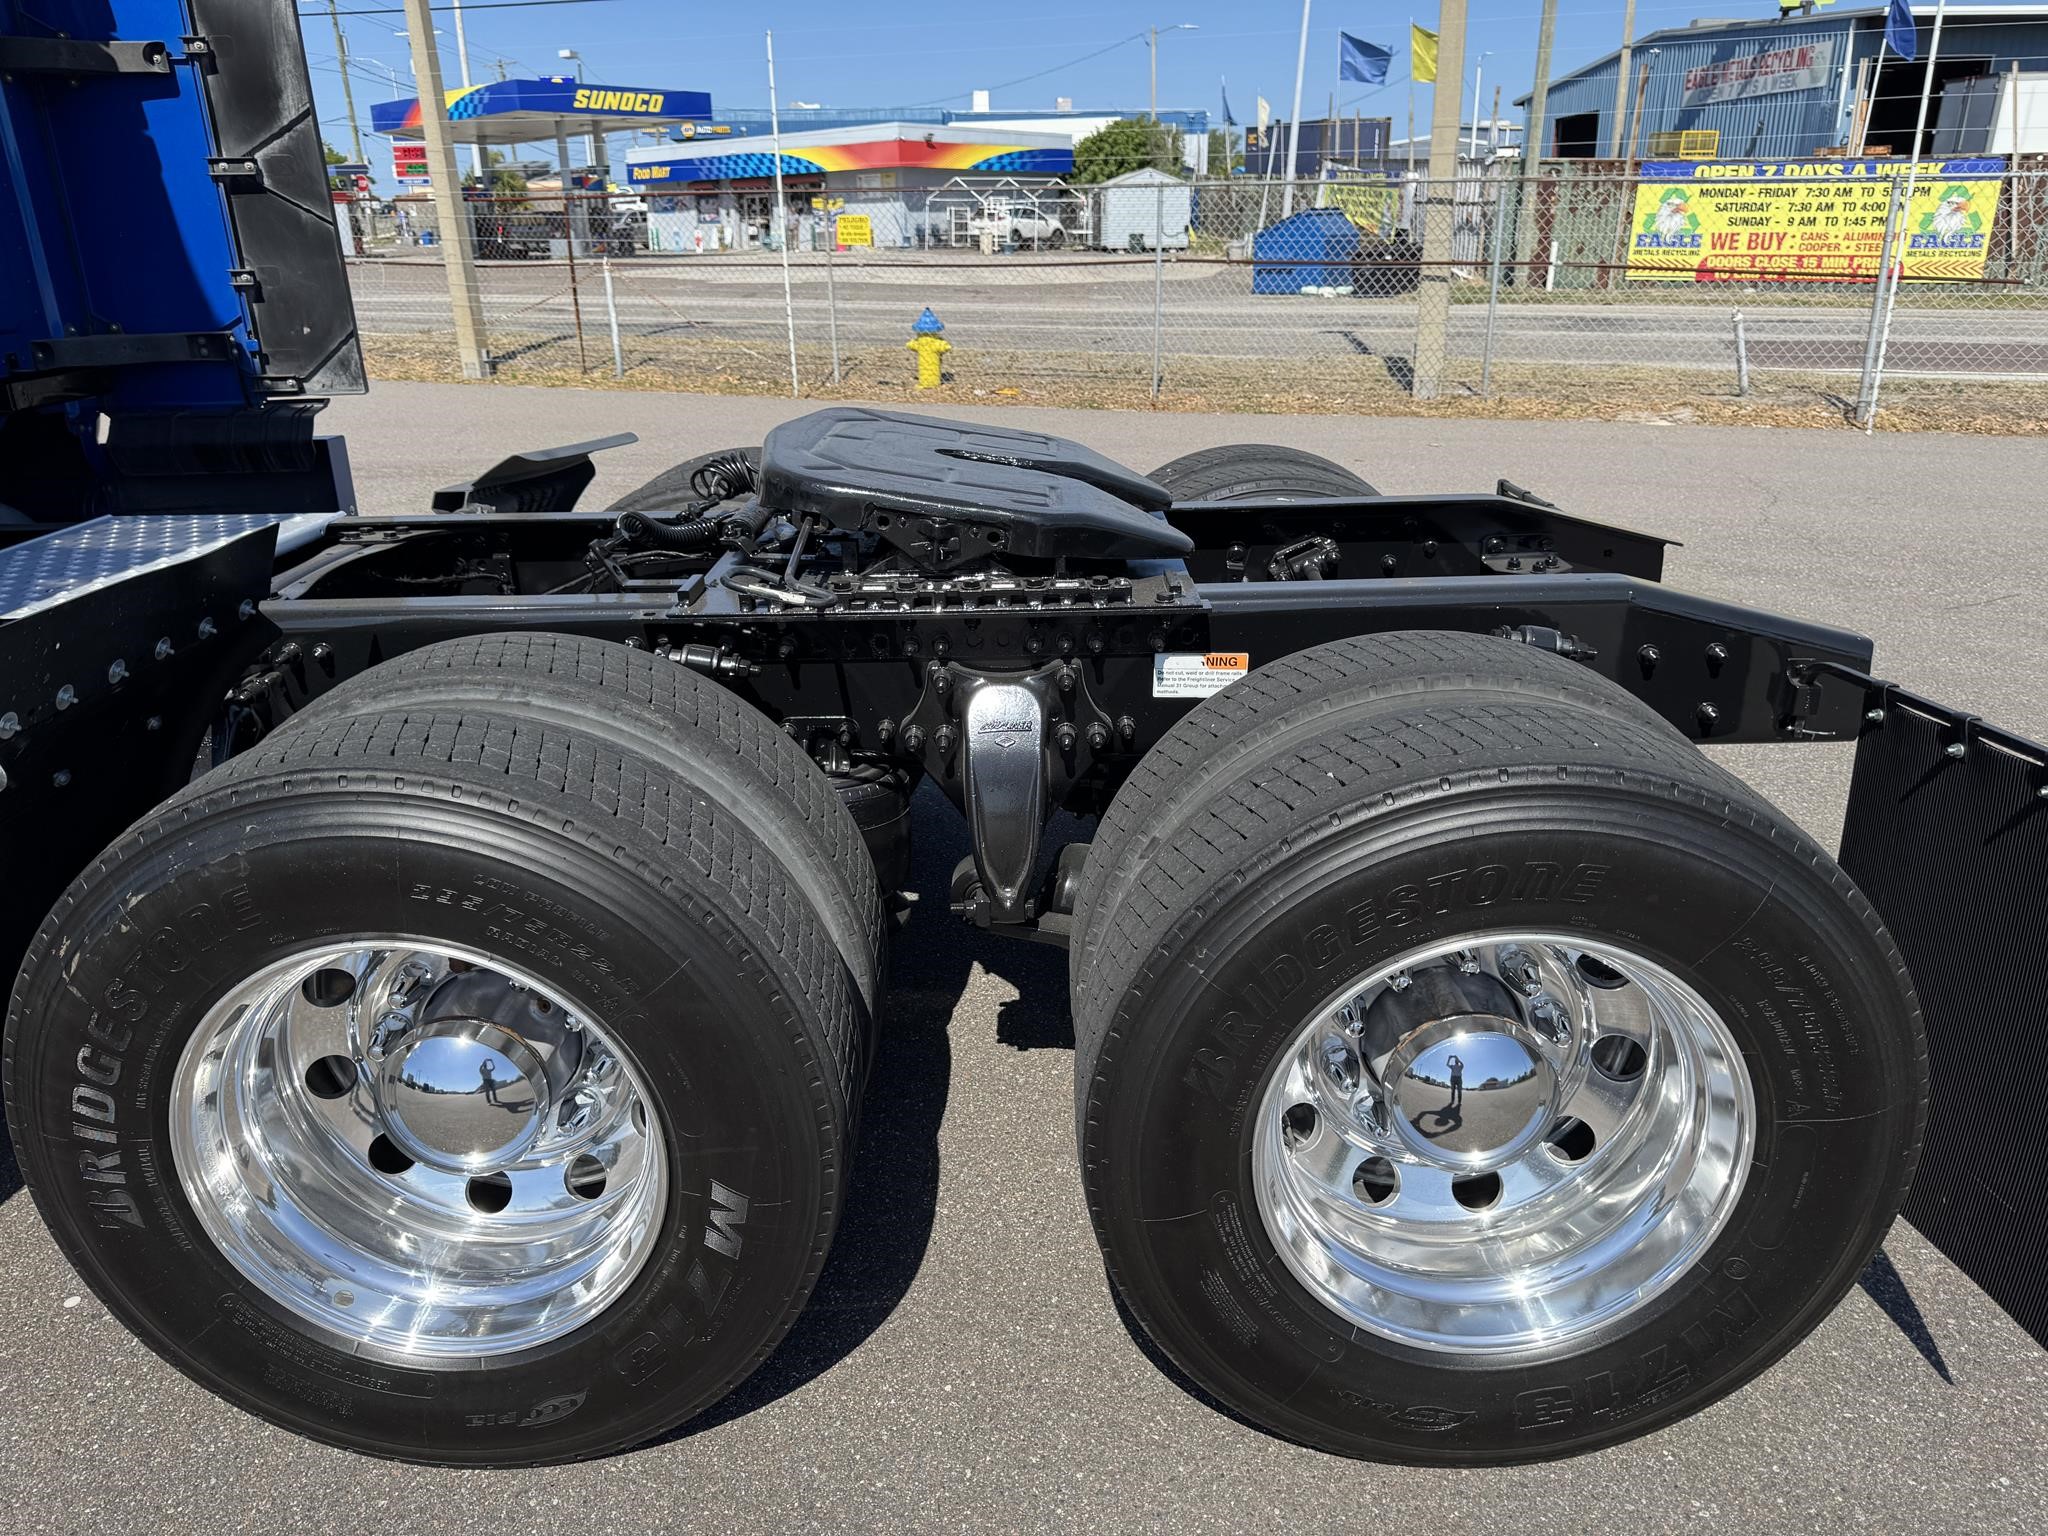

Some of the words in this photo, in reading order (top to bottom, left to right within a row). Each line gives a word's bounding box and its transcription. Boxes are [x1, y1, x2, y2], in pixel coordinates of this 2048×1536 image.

[1685, 64, 1720, 91] EAGLE
[1758, 45, 1816, 77] RECYCLING
[573, 89, 665, 113] SUNOCO
[1694, 165, 1755, 180] OPEN
[1783, 164, 1844, 180] DAYS
[1876, 162, 1946, 180] WEEK
[1699, 188, 1746, 198] MONDAY
[1758, 188, 1798, 198] FRIDAY
[1805, 187, 1830, 198] 7:30
[1833, 187, 1852, 197] AM
[1861, 187, 1875, 197] TO
[1882, 187, 1908, 198] 5:0
[1912, 186, 1931, 197] PM
[1714, 202, 1772, 212] SATURDAY
[1788, 202, 1812, 212] 7:30
[1815, 202, 1834, 212] AM
[1843, 202, 1857, 212] TO
[1860, 202, 1886, 212] 4:00
[1727, 216, 1772, 226] SUNDAY
[1787, 217, 1795, 226] 9
[1798, 217, 1816, 226] AM
[1825, 216, 1839, 226] TO
[1843, 217, 1867, 226] 1:45
[1635, 233, 1702, 248] EAGLE
[1711, 232, 1740, 251] WE
[1746, 231, 1788, 251] BUY
[1798, 242, 1841, 252] COOPER
[1854, 242, 1884, 252] STEE
[1909, 233, 1985, 248] EAGLE
[1905, 250, 1936, 258] METALS
[1707, 256, 1752, 268] DOORS
[1755, 256, 1798, 268] CLOSE
[1803, 256, 1818, 268] 15
[1821, 256, 1849, 269] MIN
[1184, 861, 1612, 1101] BRIDGESTONE
[72, 882, 264, 1231] BRIDGESTONE
